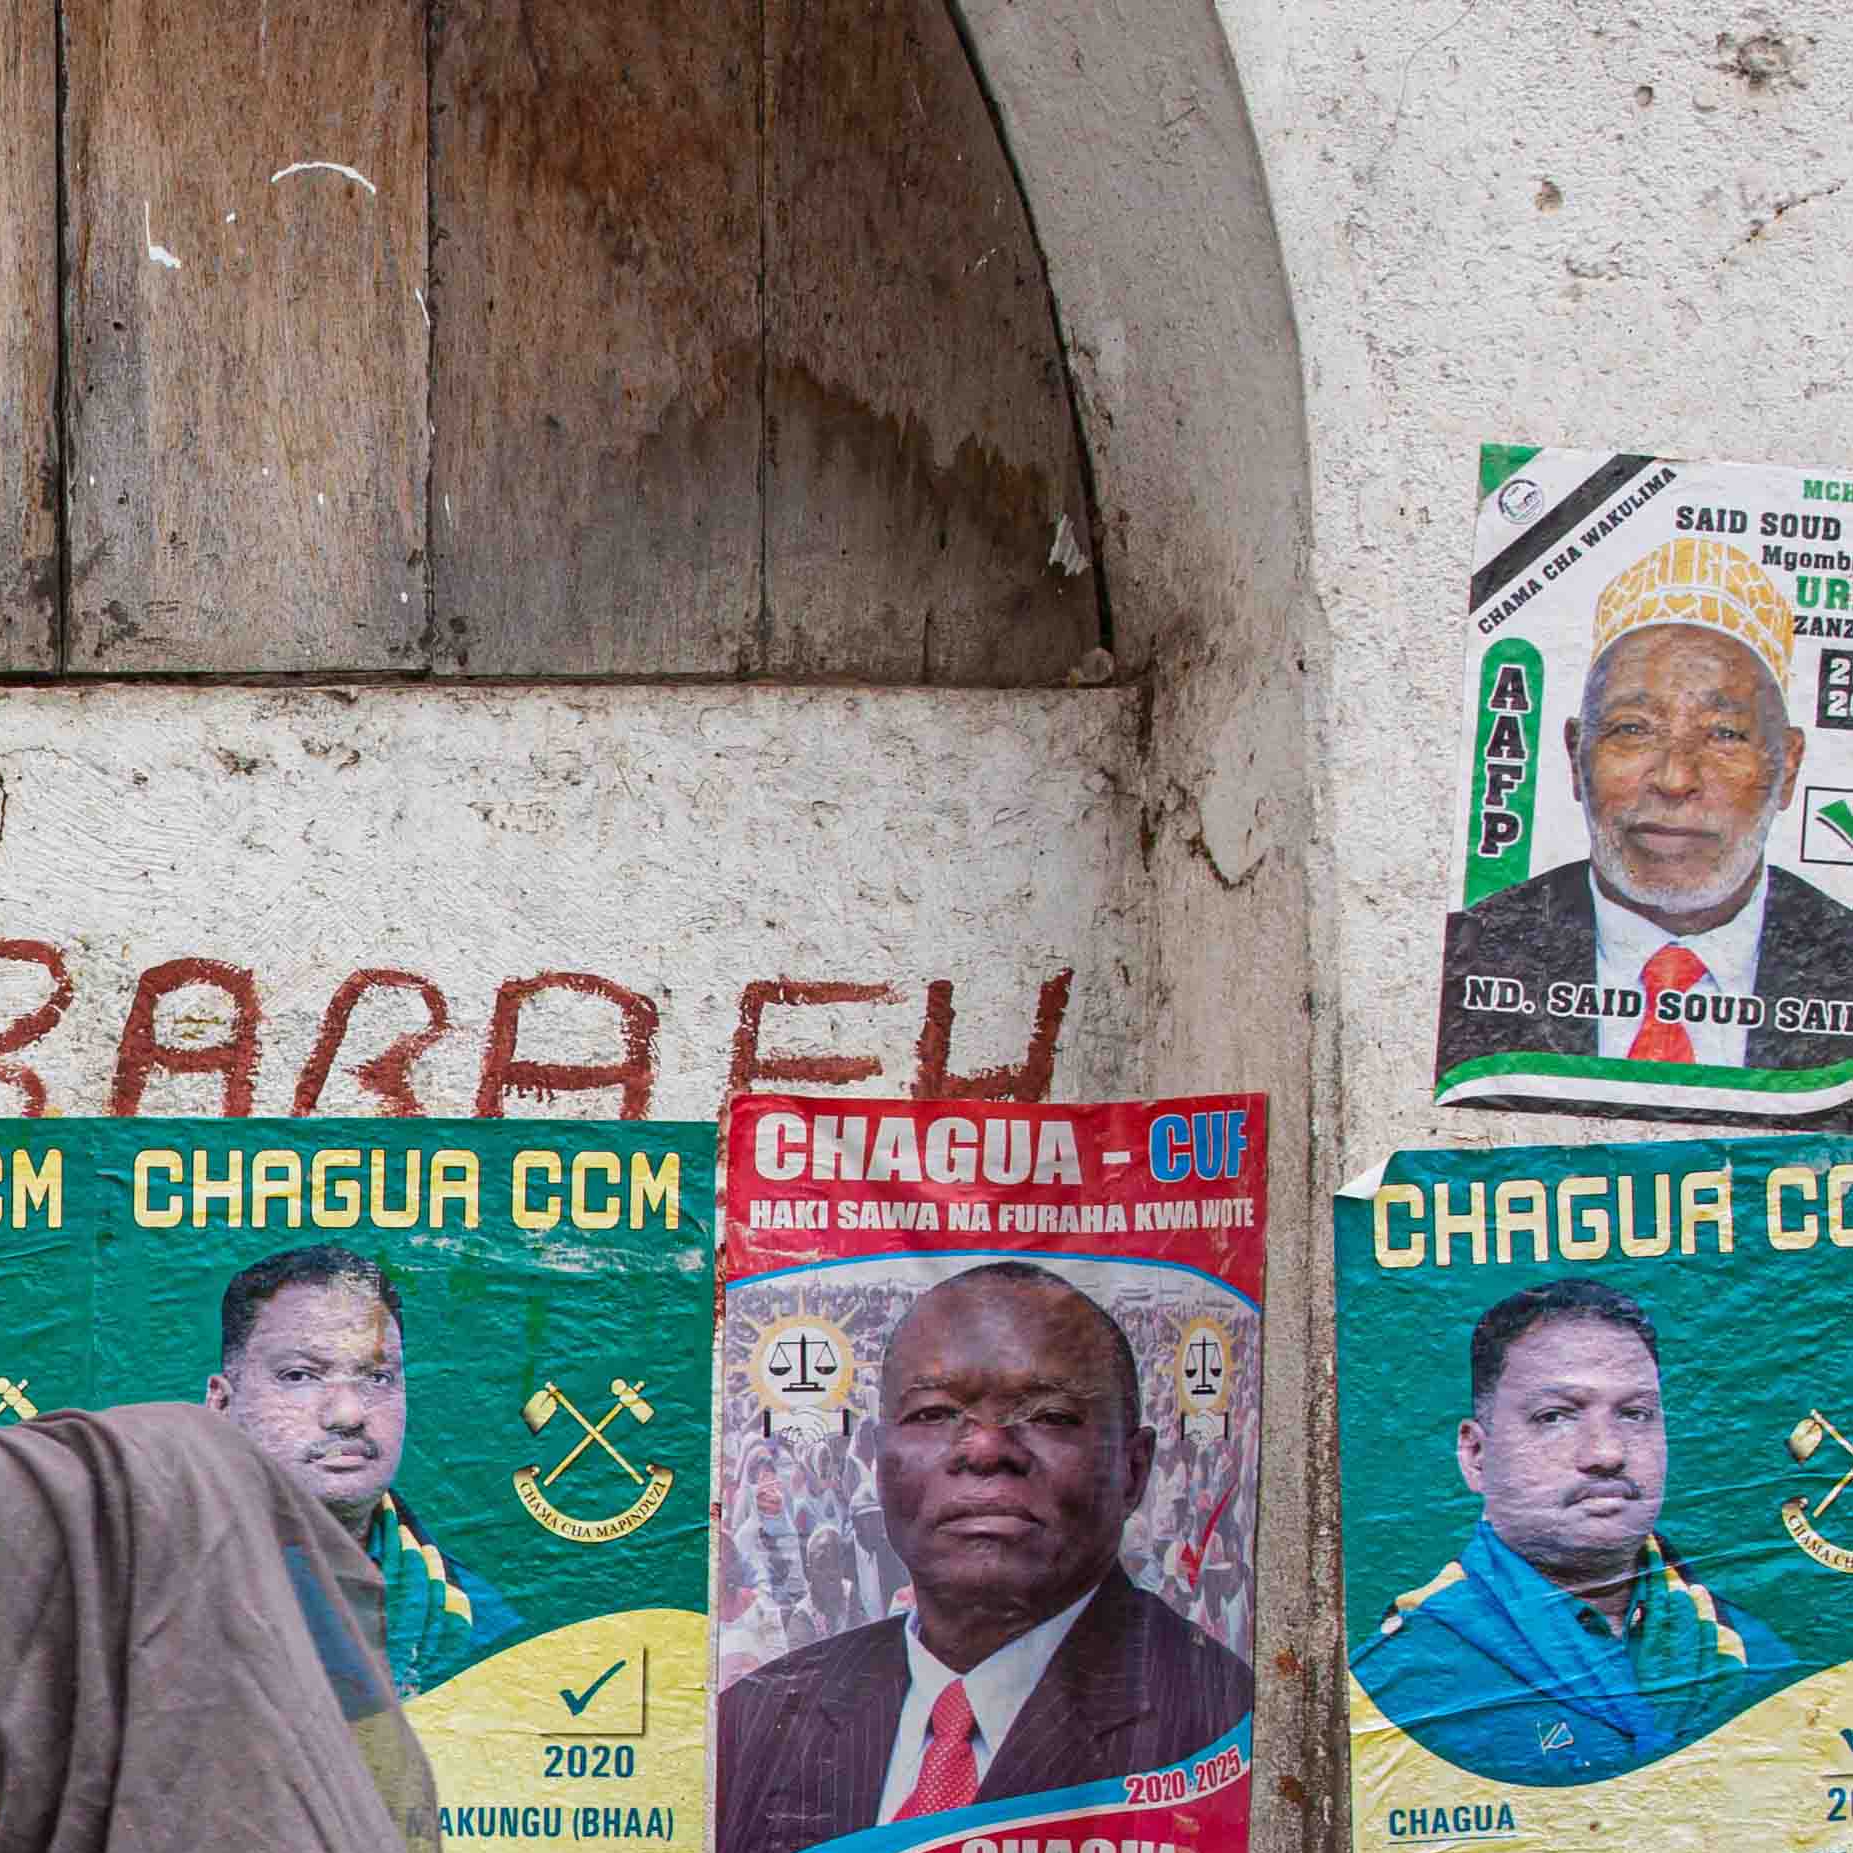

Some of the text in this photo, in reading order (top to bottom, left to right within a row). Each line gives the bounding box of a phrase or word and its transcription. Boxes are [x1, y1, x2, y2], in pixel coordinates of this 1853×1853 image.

[1477, 578, 1543, 636] CHAMA
[1541, 545, 1584, 582] CHA
[1580, 465, 1680, 549] WAKULIMA
[1675, 506, 1842, 541] SAID SOUD
[1463, 975, 1766, 1029] ND. SAID SOUD
[753, 1109, 1250, 1185] CHAGUA CUF
[132, 1148, 681, 1231] CHAGUA CCM
[749, 1197, 1255, 1233] HAKI SAWA NA FURAHA KWA WOTE
[1373, 1169, 1735, 1269] CHAGUA
[519, 1481, 666, 1538] CHAMA CHA MAPINDUZI
[543, 1744, 635, 1779] 2020
[1124, 1745, 1243, 1805] 2020 2025
[572, 1806, 675, 1842] (BHAA)
[1388, 1802, 1517, 1837] CHAGUA
